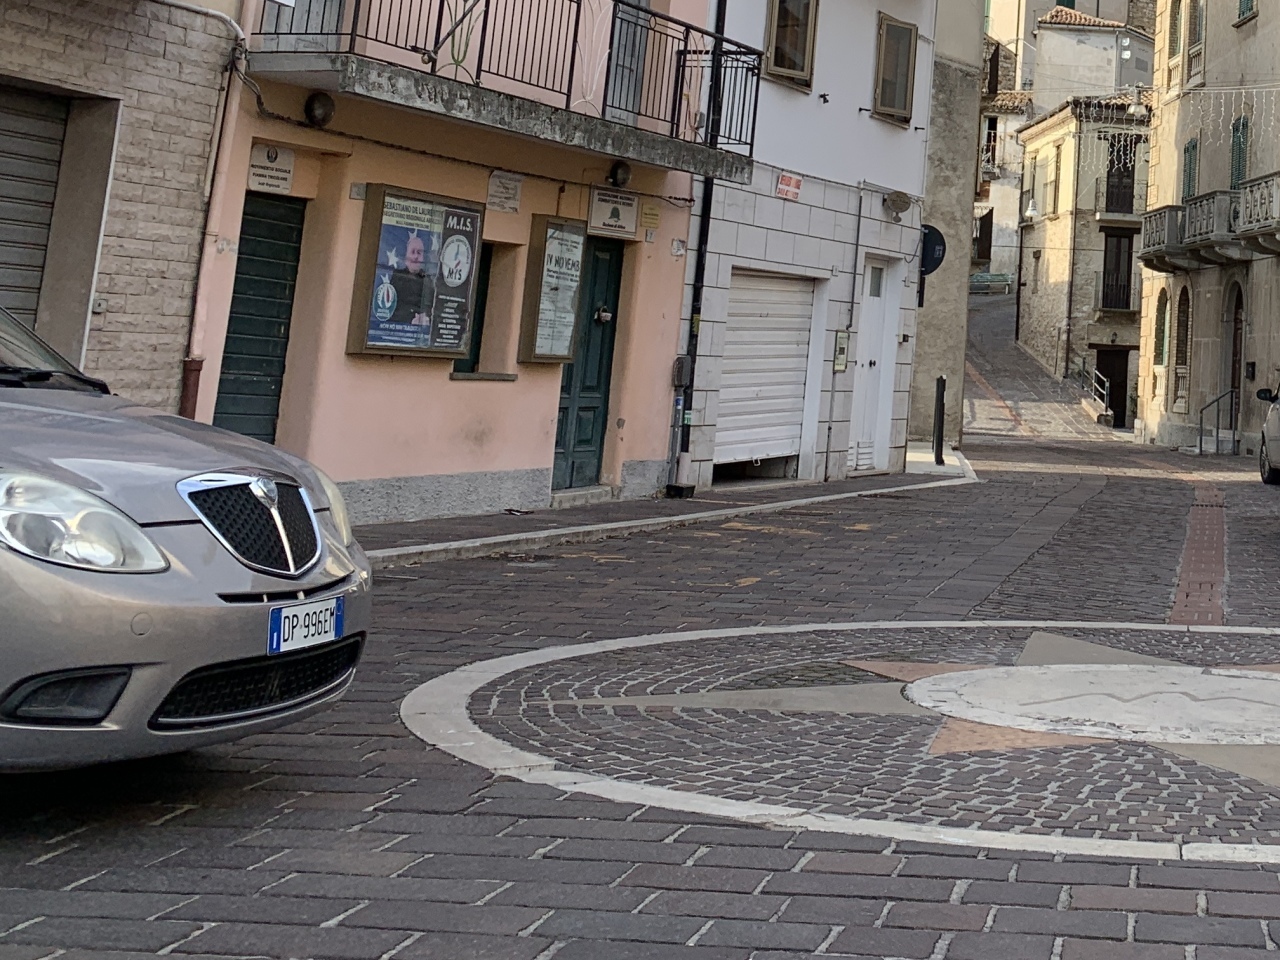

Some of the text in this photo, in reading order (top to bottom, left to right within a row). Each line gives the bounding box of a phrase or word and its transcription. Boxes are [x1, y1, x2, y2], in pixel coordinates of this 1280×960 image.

[447, 215, 473, 232] M.I.S.
[447, 268, 461, 280] MIS
[303, 606, 335, 638] 996EM
